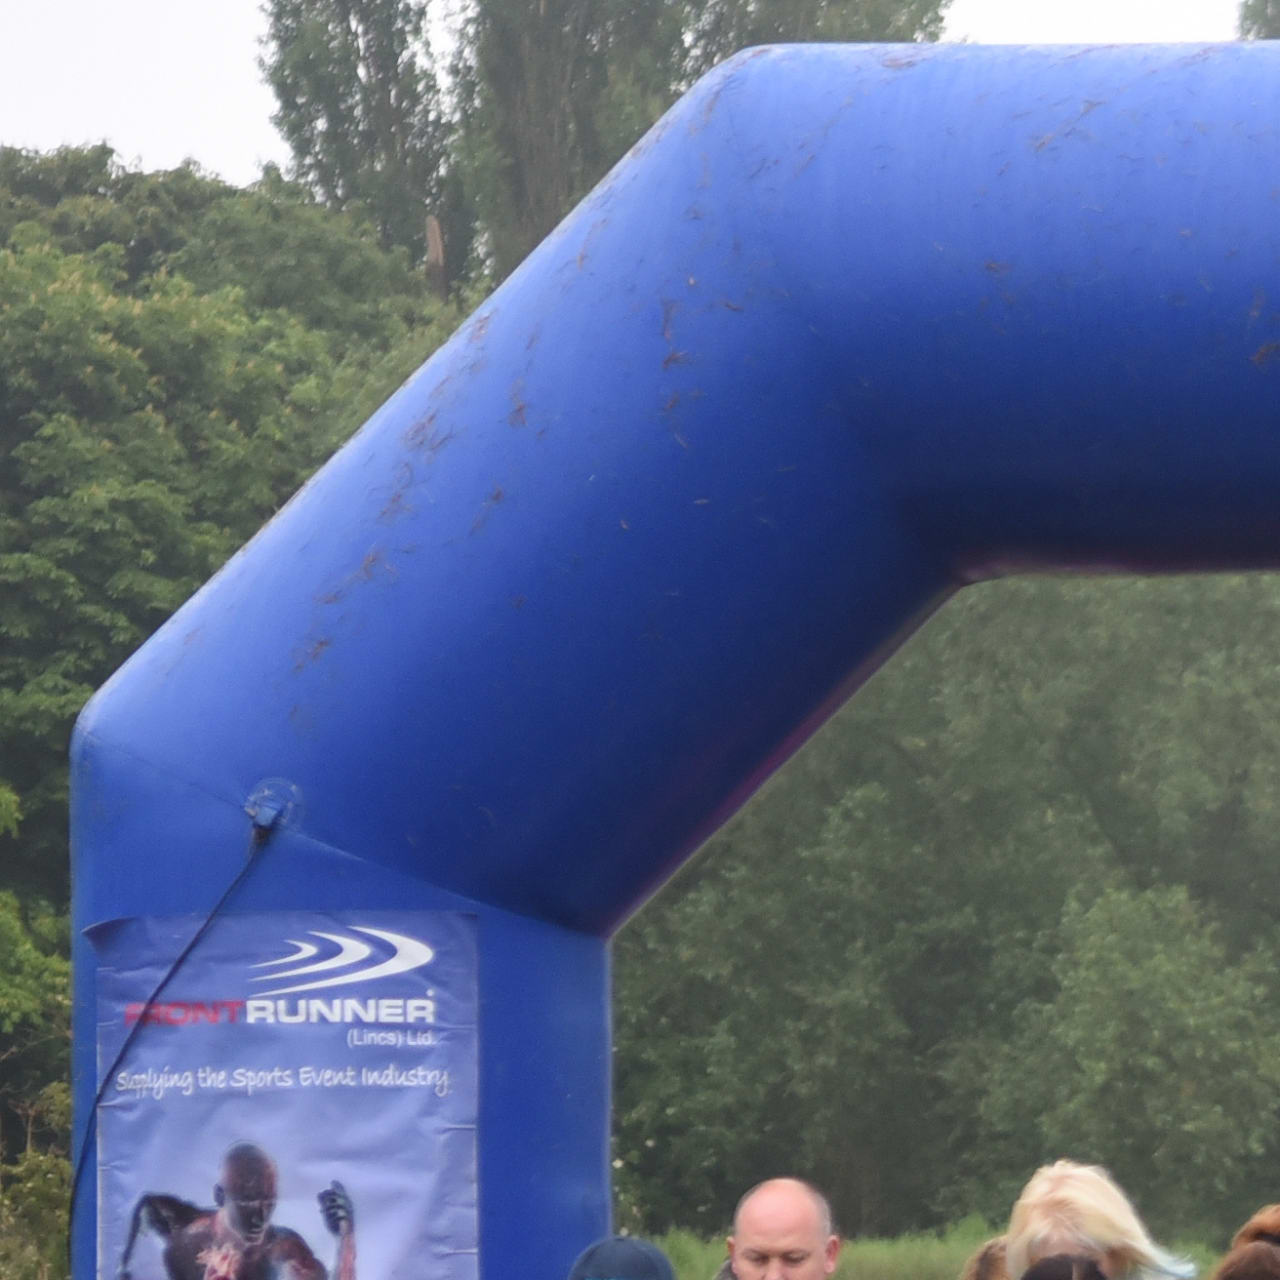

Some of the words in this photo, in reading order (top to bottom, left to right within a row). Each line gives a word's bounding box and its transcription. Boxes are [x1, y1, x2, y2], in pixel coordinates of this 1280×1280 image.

[124, 999, 435, 1026] FRONTRUNNER
[347, 1030, 399, 1047] (Lincs)
[115, 1068, 193, 1099] Supplying
[198, 1068, 227, 1089] the
[230, 1067, 294, 1096] Sports
[299, 1066, 355, 1086] Event
